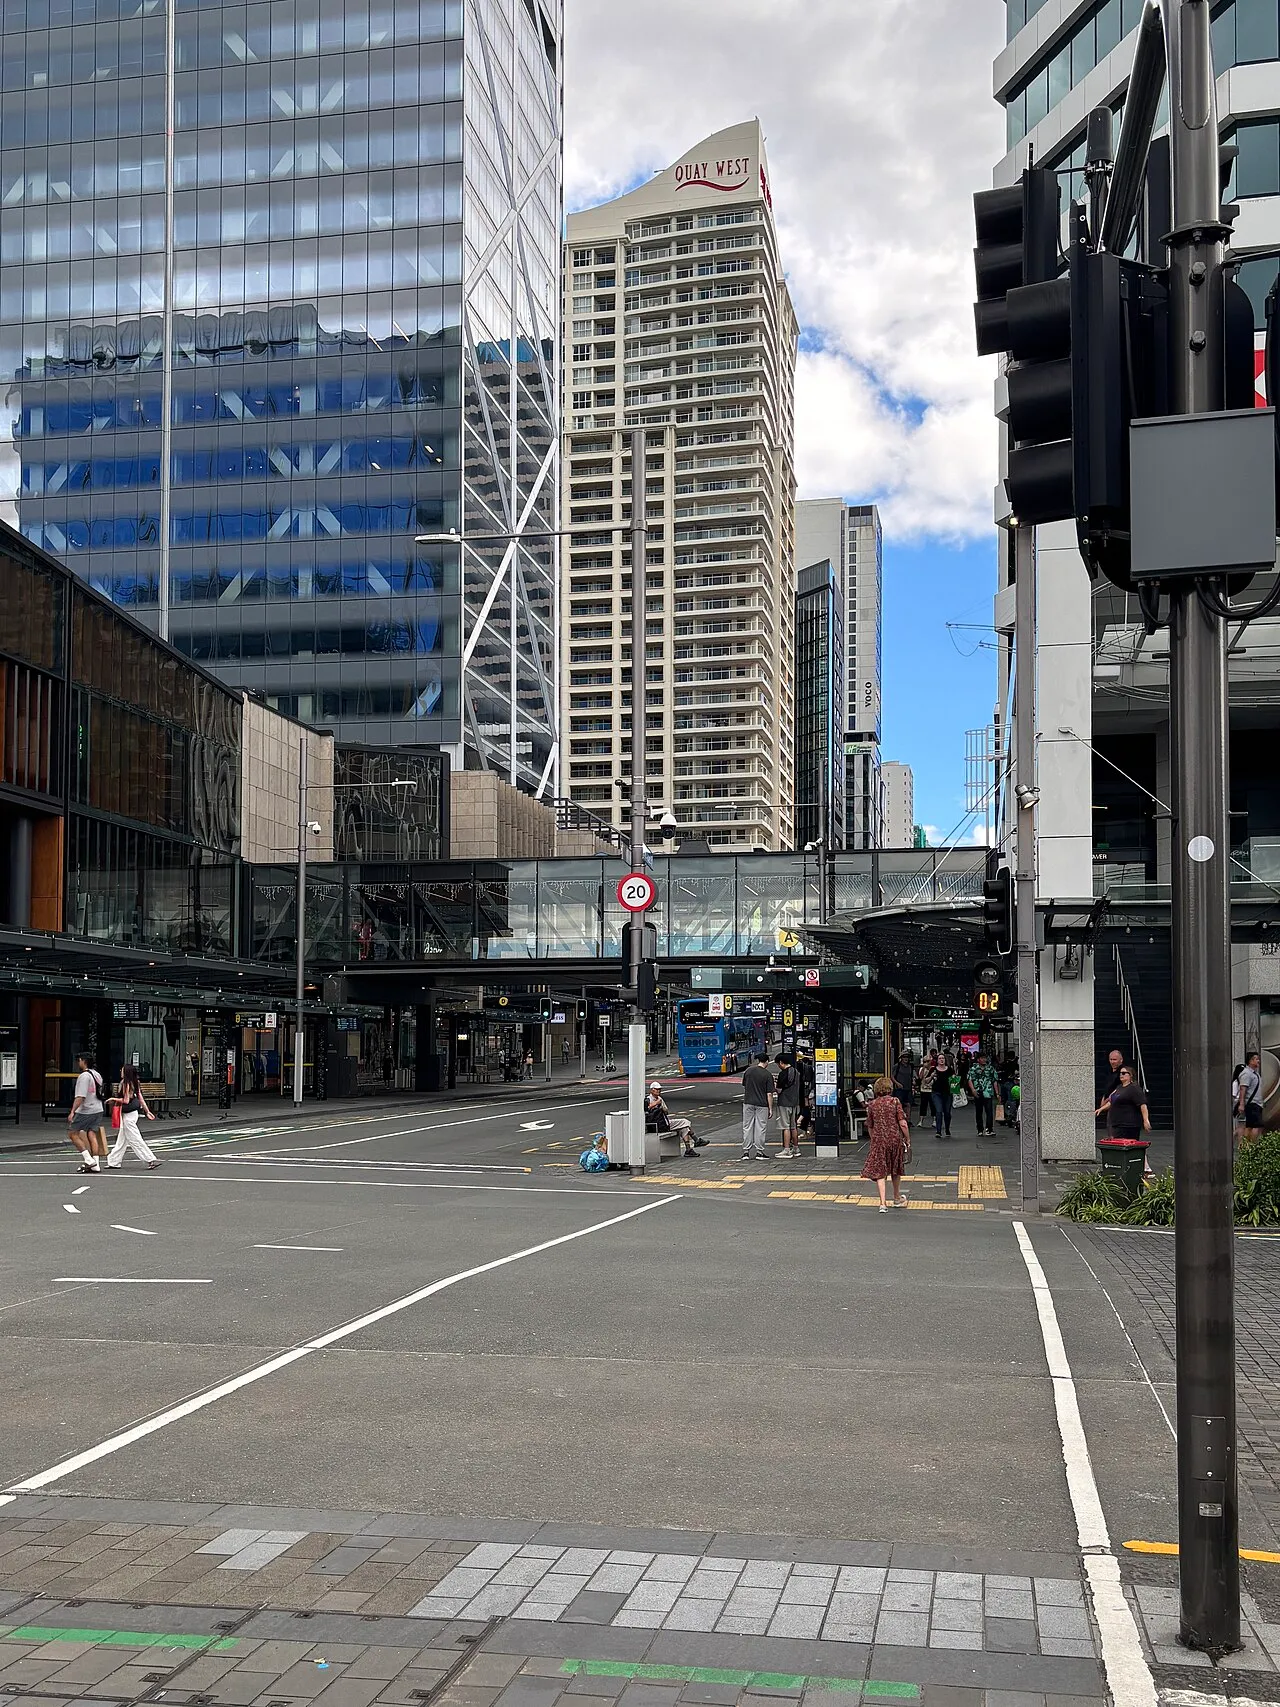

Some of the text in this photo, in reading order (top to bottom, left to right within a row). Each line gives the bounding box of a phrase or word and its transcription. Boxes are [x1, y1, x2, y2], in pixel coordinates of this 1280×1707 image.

[675, 158, 750, 182] QUAY WEST
[627, 885, 646, 899] 20
[784, 931, 794, 943] A
[980, 993, 999, 1010] 02
